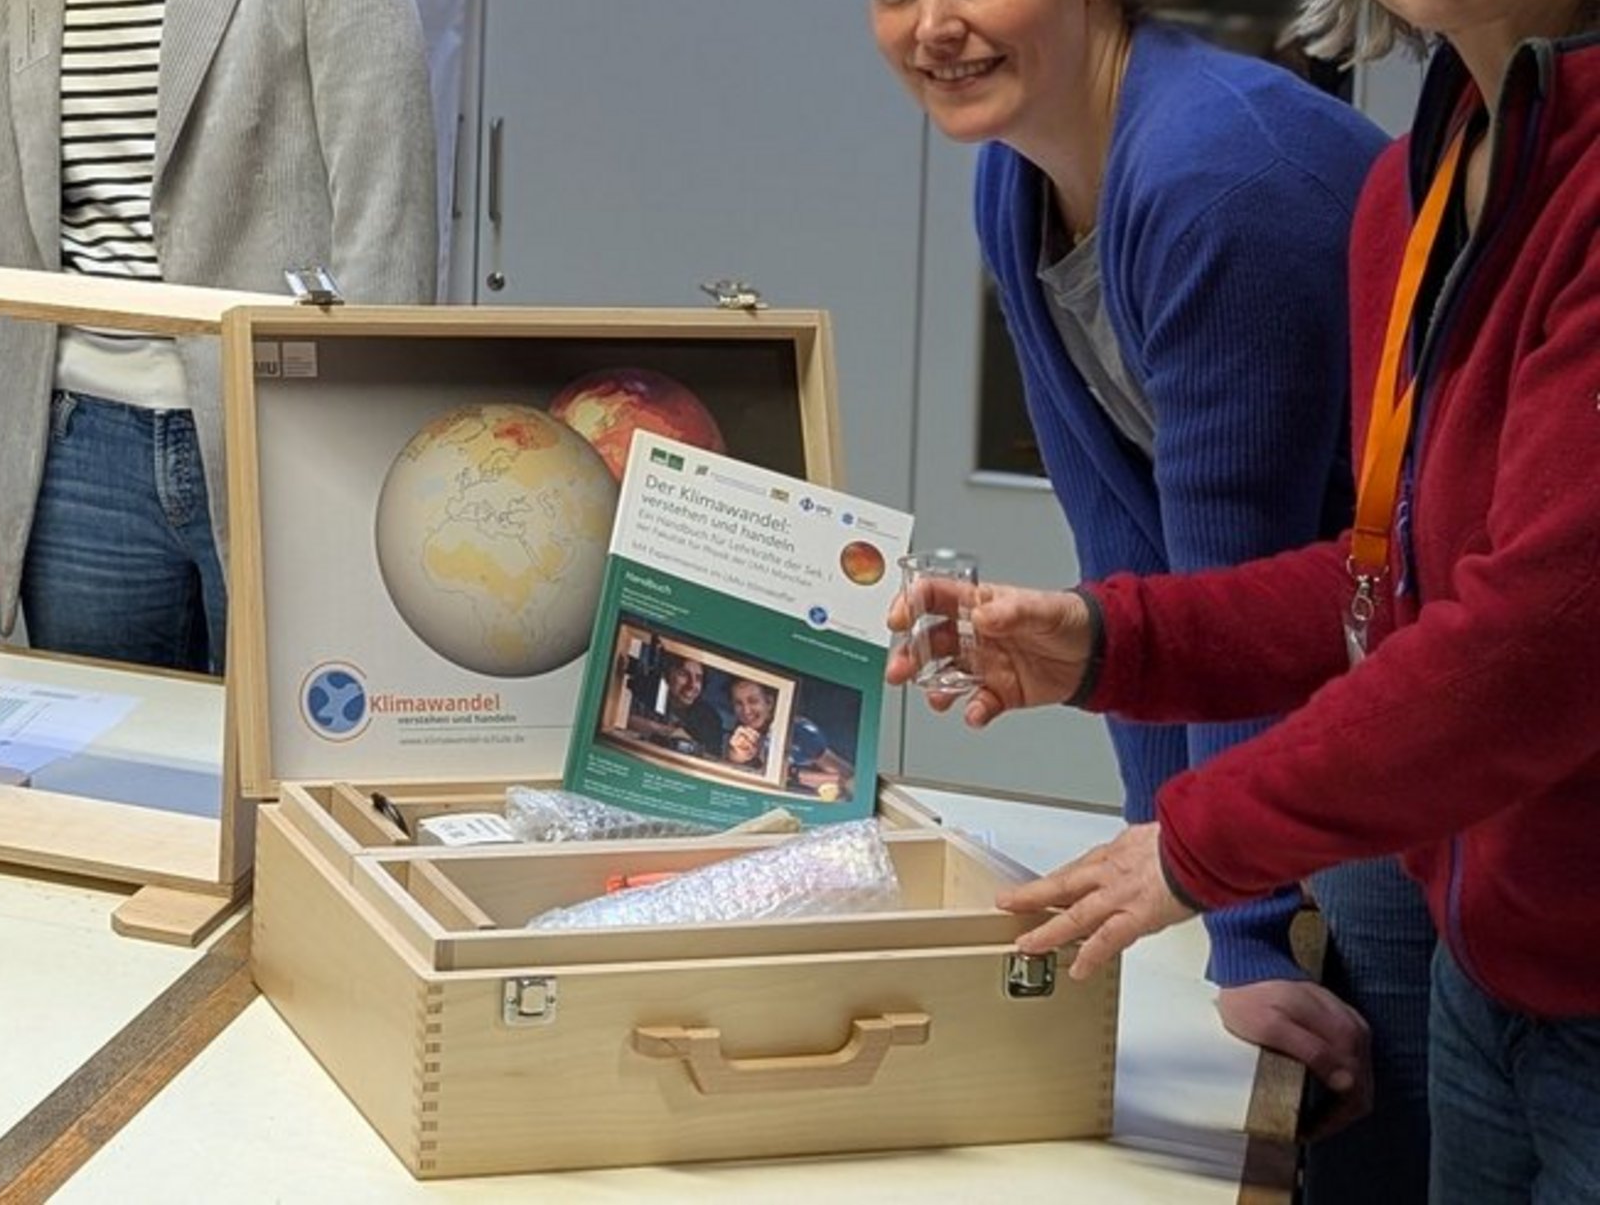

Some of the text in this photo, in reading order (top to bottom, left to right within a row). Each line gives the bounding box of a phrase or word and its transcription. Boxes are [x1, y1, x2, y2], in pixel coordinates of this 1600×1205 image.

[644, 473, 677, 496] Der
[678, 485, 792, 534] Klimawandel:
[709, 516, 738, 534] und
[739, 525, 796, 553] handeln
[370, 694, 500, 713] Klimawandel
[452, 715, 473, 724] und
